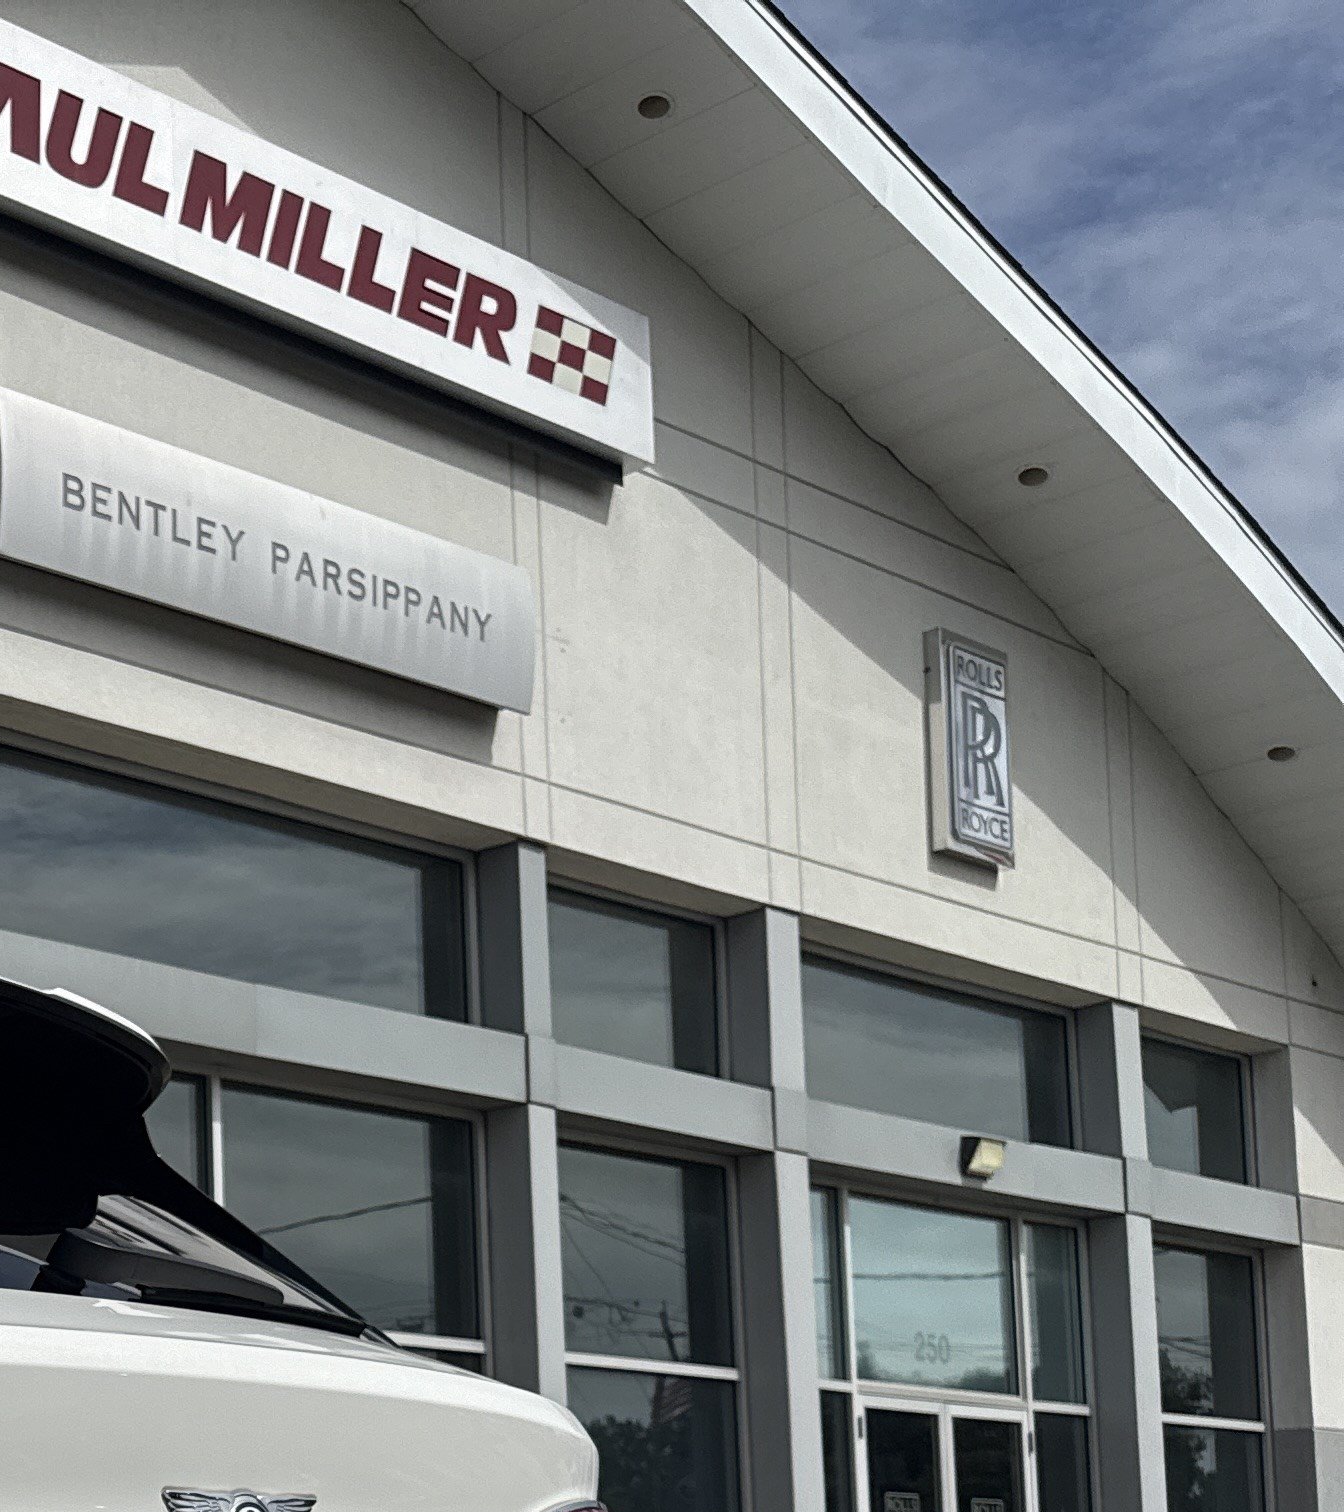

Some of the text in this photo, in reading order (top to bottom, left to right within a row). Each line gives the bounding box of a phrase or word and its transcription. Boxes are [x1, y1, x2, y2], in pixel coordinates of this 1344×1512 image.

[179, 149, 518, 366] MILLER
[61, 472, 492, 642] BENTLEY PARSIPPANY
[956, 655, 1002, 691] ROLLS
[962, 808, 1009, 842] ROYCE
[914, 1331, 950, 1364] 250
